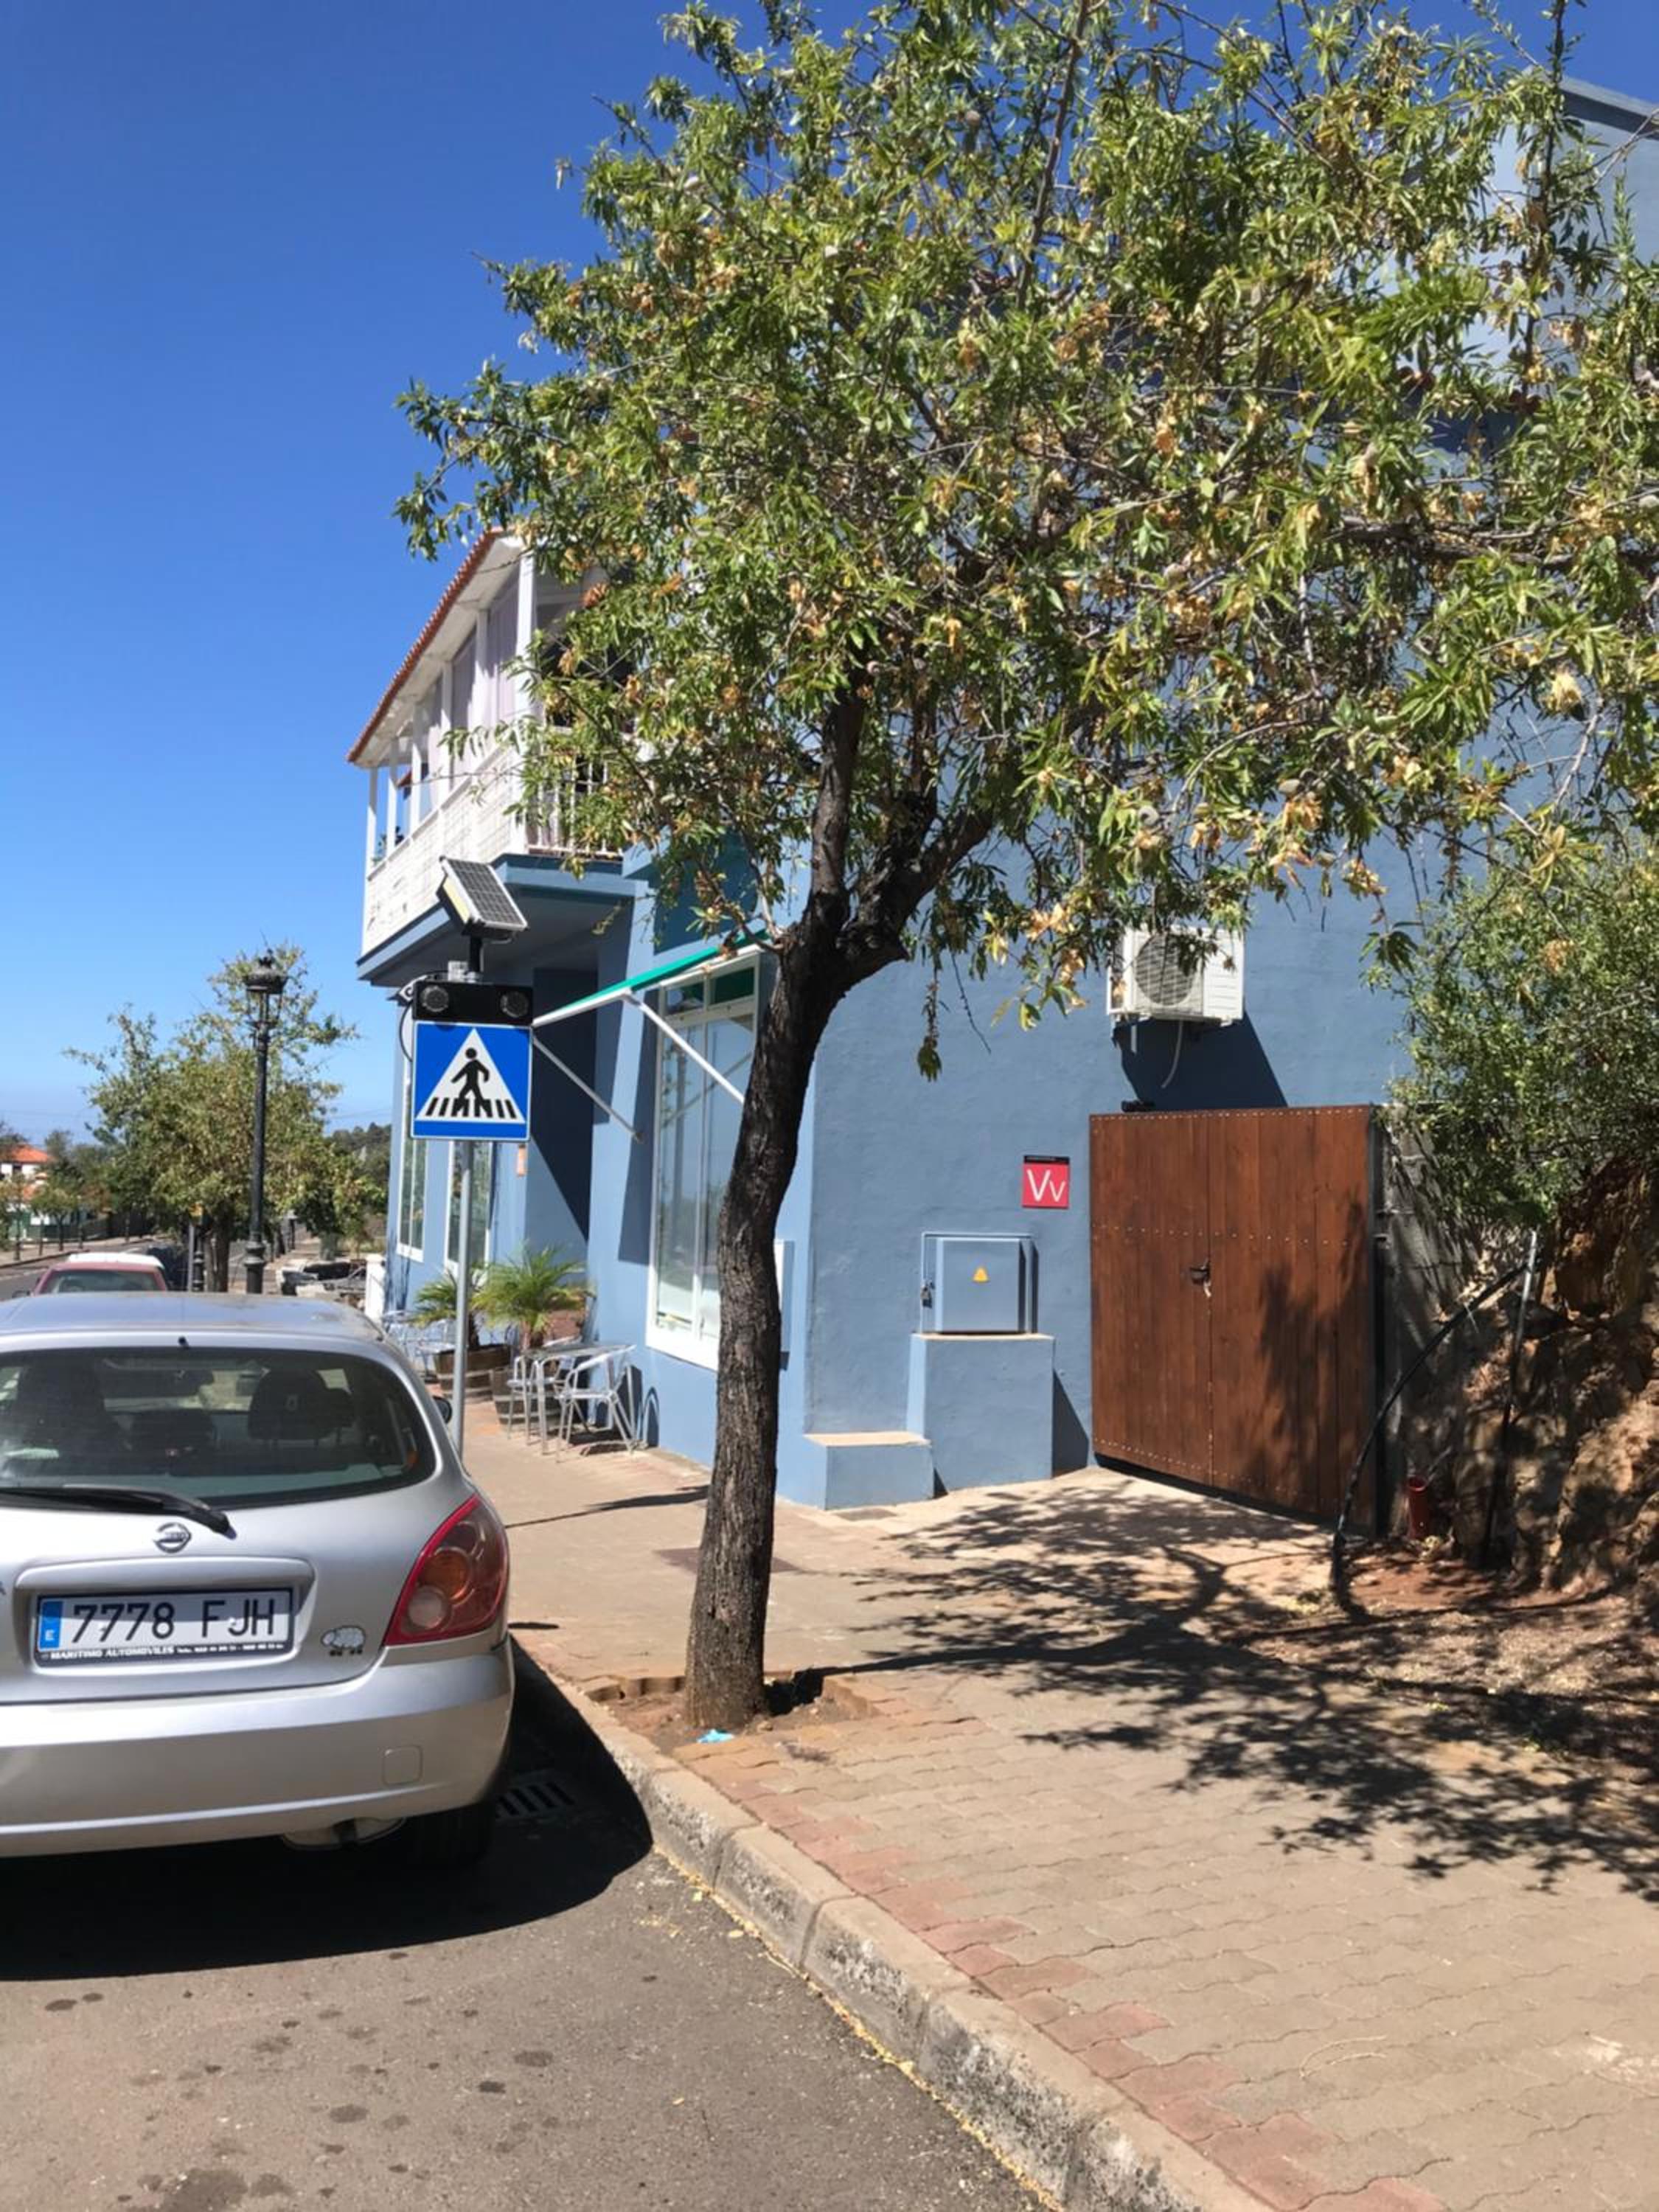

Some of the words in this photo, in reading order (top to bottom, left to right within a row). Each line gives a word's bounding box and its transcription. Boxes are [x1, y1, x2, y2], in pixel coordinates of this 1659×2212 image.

[73, 1601, 175, 1644] 7778
[201, 1599, 275, 1638] FJH
[45, 1629, 55, 1641] E
[105, 1646, 175, 1658] AUTOMOVILES
